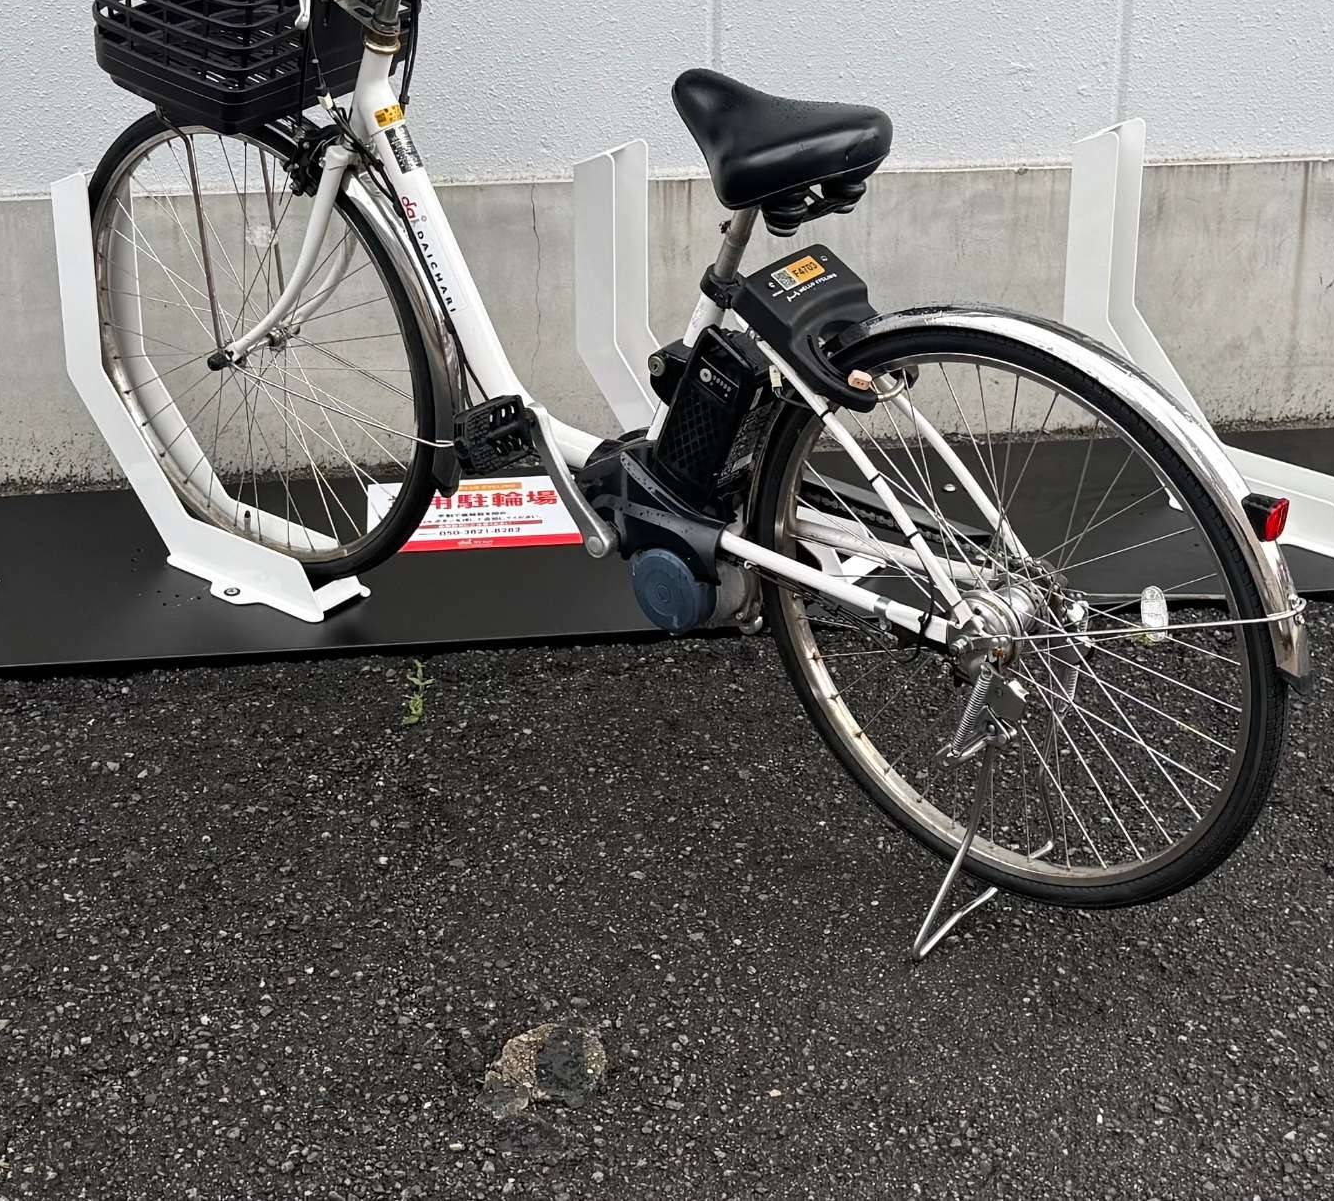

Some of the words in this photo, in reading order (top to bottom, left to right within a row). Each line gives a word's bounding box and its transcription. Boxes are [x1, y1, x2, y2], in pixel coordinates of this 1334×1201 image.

[417, 231, 456, 312] DAICHARI
[792, 261, 818, 278] F4703
[432, 490, 557, 510] 用駐輪場
